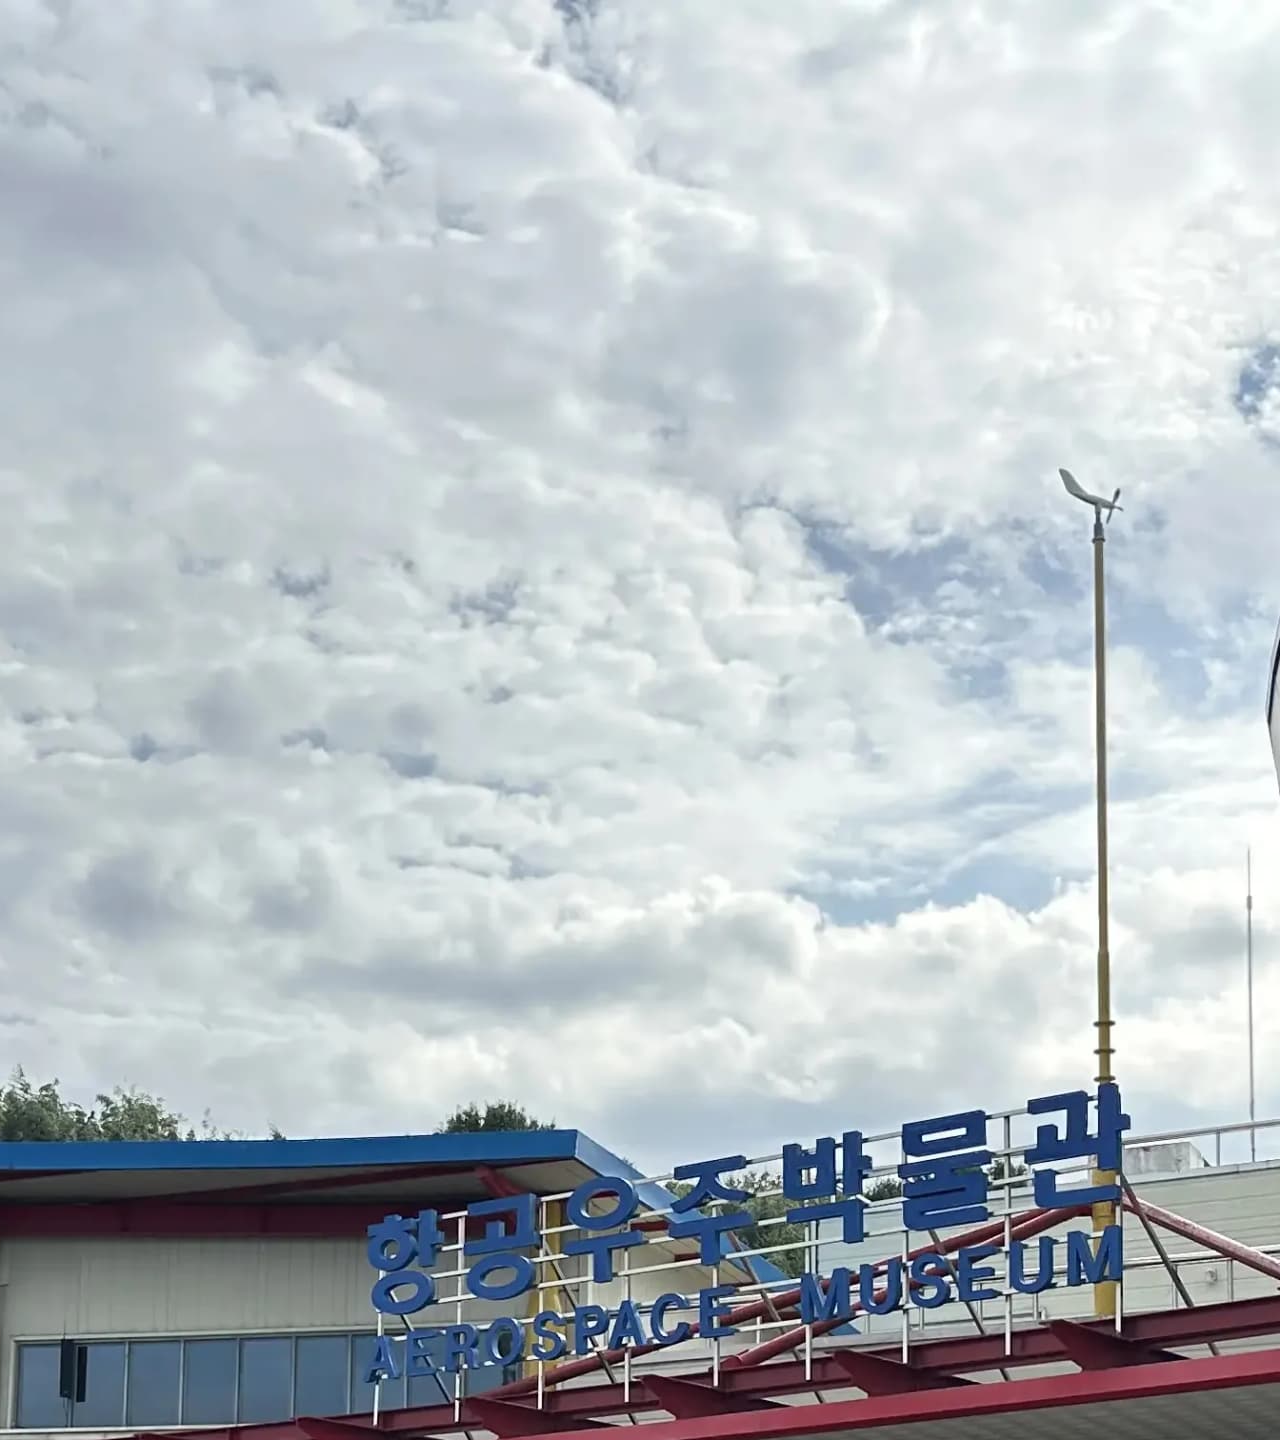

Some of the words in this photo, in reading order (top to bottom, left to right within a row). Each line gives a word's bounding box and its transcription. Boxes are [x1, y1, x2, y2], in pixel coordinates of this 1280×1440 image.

[367, 1082, 1131, 1315] 항공우주박물관
[364, 1284, 740, 1384] AEROSPACE
[801, 1224, 1122, 1326] MUSEUM
